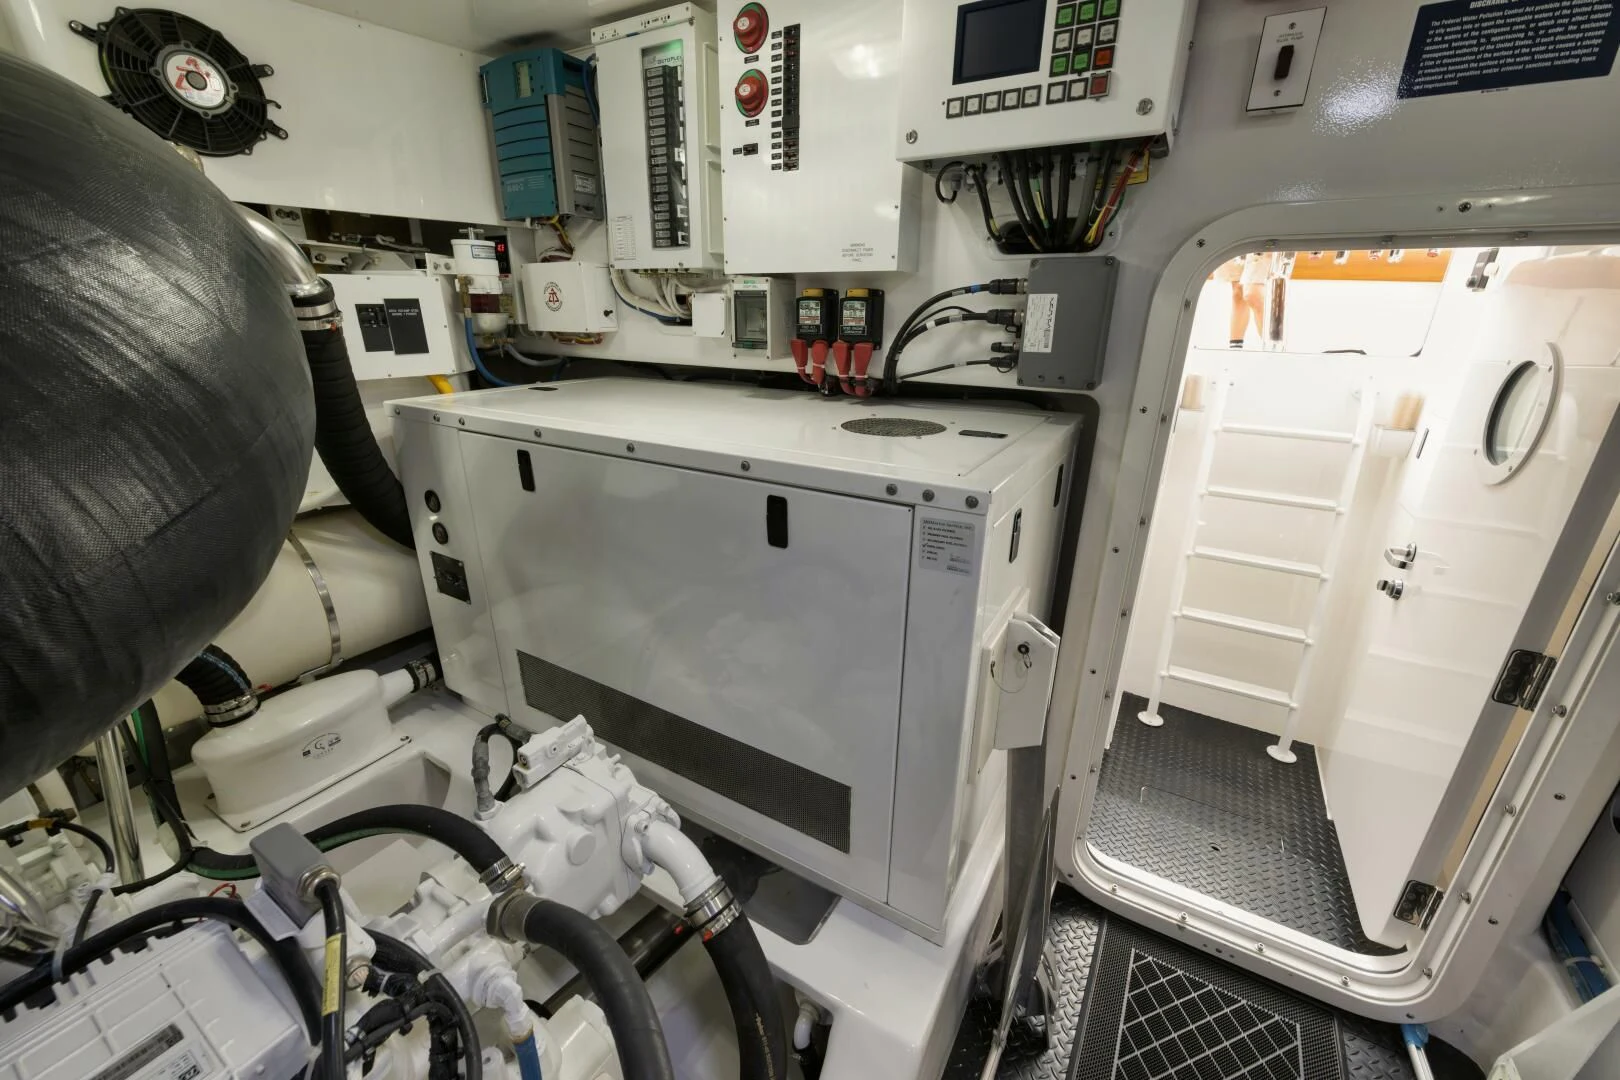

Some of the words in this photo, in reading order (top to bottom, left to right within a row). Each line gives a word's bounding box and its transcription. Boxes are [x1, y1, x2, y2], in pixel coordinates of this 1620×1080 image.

[1479, 11, 1503, 19] Pollution
[1535, 2, 1560, 11] prohibits
[1506, 15, 1532, 23] navigable
[1452, 40, 1477, 48] belonging
[1491, 33, 1525, 42] appertaining
[1580, 21, 1608, 29] exclusive
[1481, 27, 1510, 35] contiguous
[1422, 50, 1454, 59] management
[1456, 47, 1478, 55] authority
[1555, 32, 1584, 40] discharge
[1442, 56, 1476, 64] discoloration
[1501, 64, 1523, 72] criminal
[1525, 61, 1552, 69] sanctions
